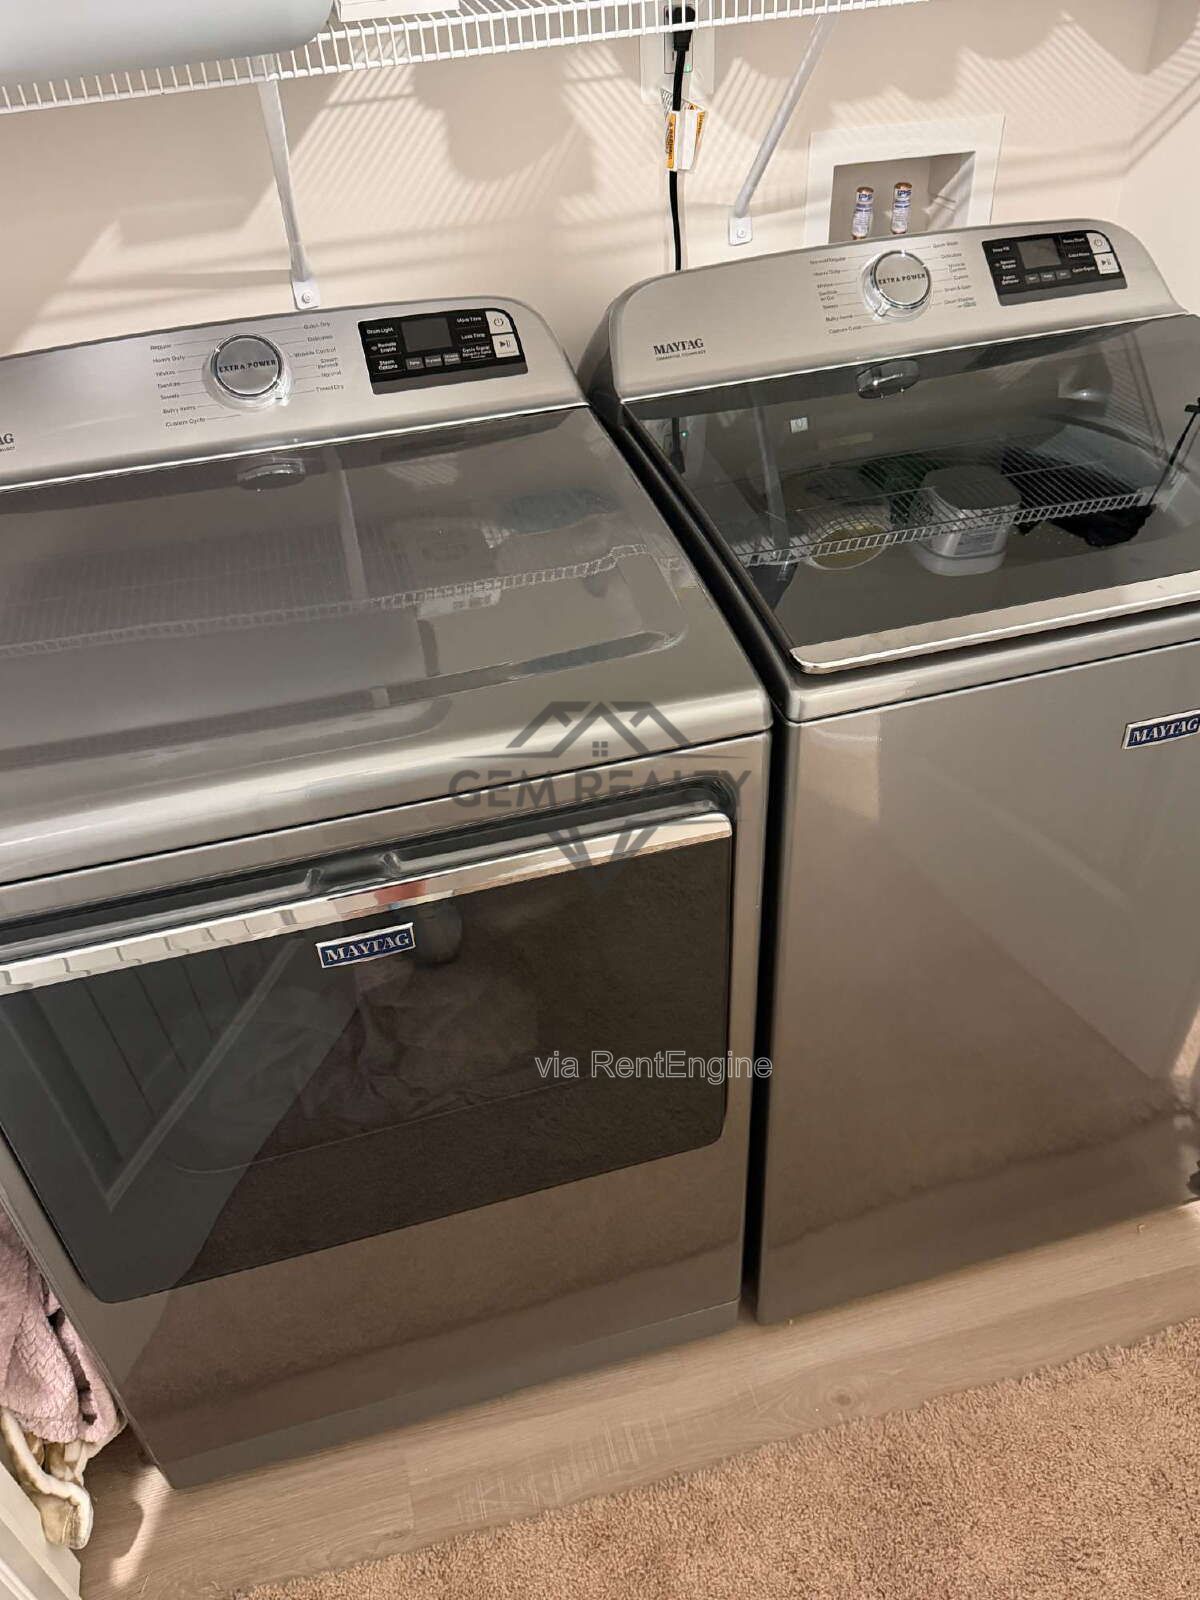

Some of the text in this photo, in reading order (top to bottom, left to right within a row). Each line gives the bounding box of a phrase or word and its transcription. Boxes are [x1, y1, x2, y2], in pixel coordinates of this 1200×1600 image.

[878, 273, 926, 285] EXTRA POWER
[653, 338, 704, 355] MAYTAG
[219, 359, 276, 373] EXTRA POWER
[1130, 717, 1199, 743] MAYTAG
[325, 932, 410, 962] MAYTAG
